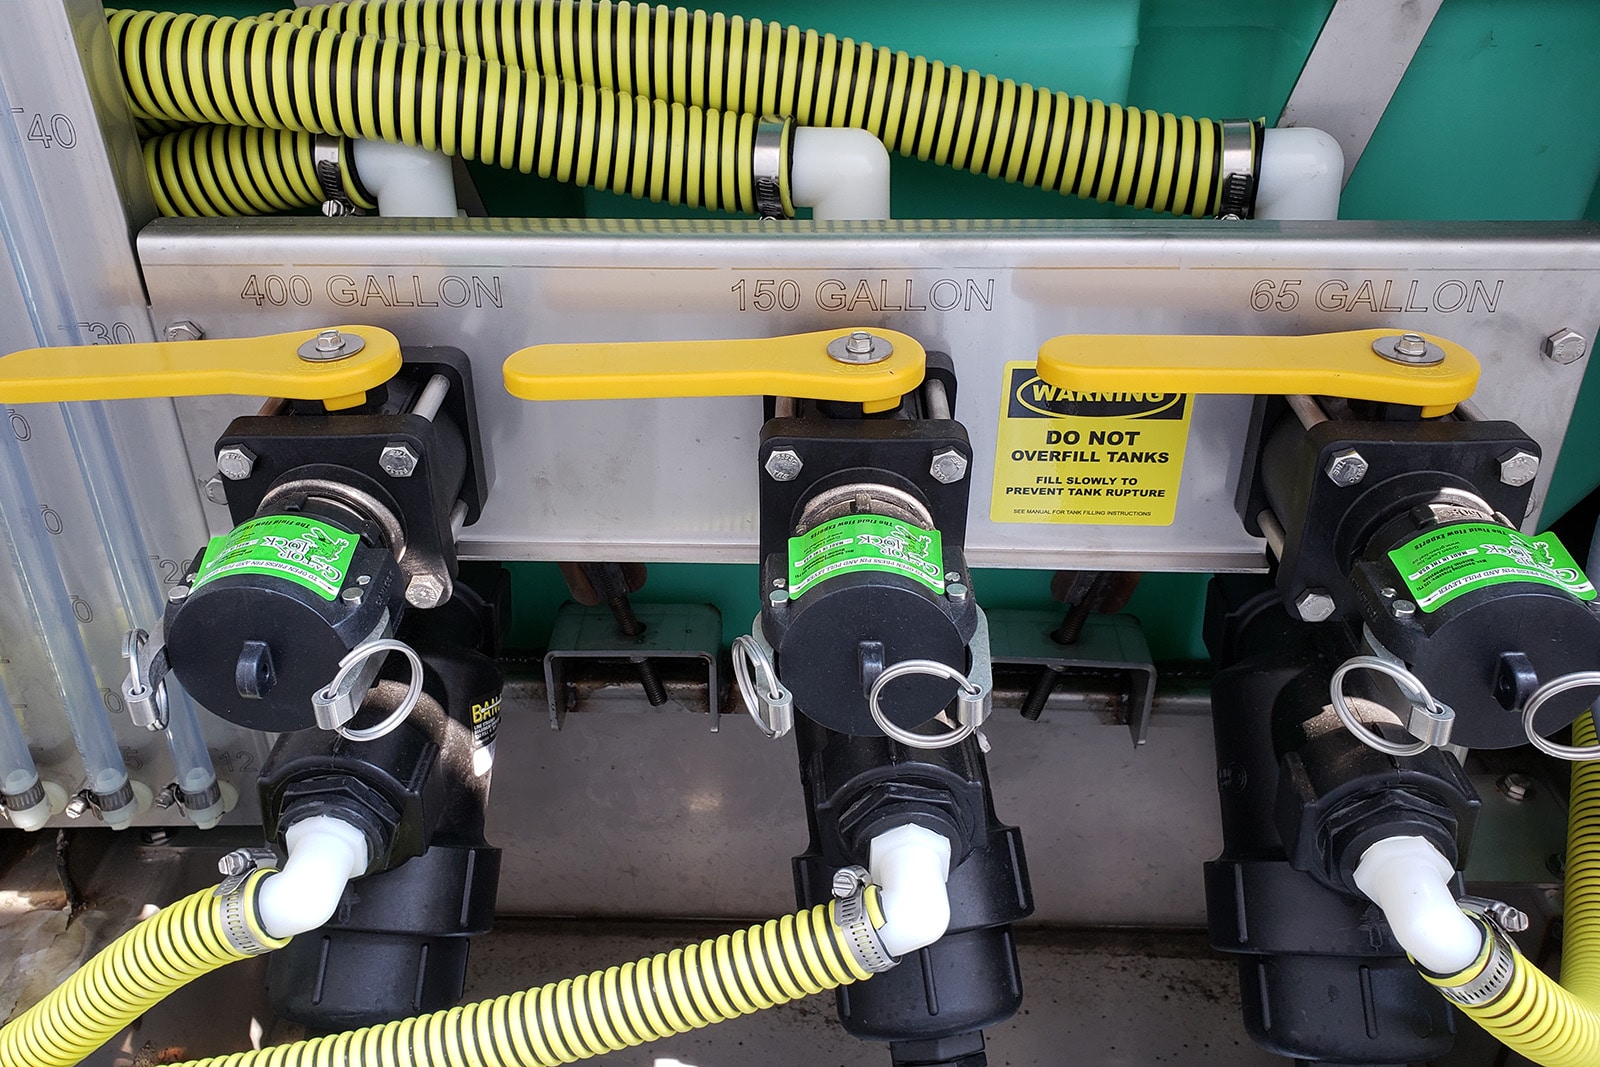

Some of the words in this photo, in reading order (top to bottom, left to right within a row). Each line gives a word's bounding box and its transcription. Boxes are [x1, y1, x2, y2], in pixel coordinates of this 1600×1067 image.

[27, 113, 77, 149] 40
[241, 274, 313, 307] 400
[325, 274, 503, 308] GALLON
[731, 279, 801, 311] 150
[815, 279, 995, 312] GALLON
[1250, 279, 1301, 312] 65
[1314, 279, 1504, 313] GALLON
[88, 322, 136, 346] 30
[1046, 430, 1080, 446] DO
[1088, 430, 1141, 446] NOT
[1011, 450, 1100, 463] OVERFILL
[1107, 451, 1169, 464] TANKS
[1036, 476, 1062, 485] FILL
[1066, 477, 1117, 486] SLOWLY
[1120, 477, 1138, 486] TO
[1005, 487, 1064, 496] PREVENT
[1067, 488, 1102, 497] TANK
[1105, 488, 1166, 498] RUPTURE
[295, 521, 310, 529] The
[810, 524, 836, 539] Experts
[1446, 529, 1467, 538] Flow
[260, 537, 308, 552] LOCK
[856, 535, 900, 549] LOCK
[1414, 533, 1446, 550] Experts
[1450, 550, 1468, 559] MADE
[265, 561, 288, 570] PRESS
[826, 563, 842, 572] PULL
[896, 563, 914, 572] OPEN
[1418, 565, 1430, 575] USA
[1430, 559, 1441, 568] THE
[289, 566, 308, 576] OPEN
[806, 569, 826, 583] LEVER
[1462, 573, 1482, 583] PULL
[1483, 569, 1500, 577] AND
[1438, 580, 1462, 595] LEVER
[472, 697, 501, 724] BAN
[219, 750, 258, 772] 12
